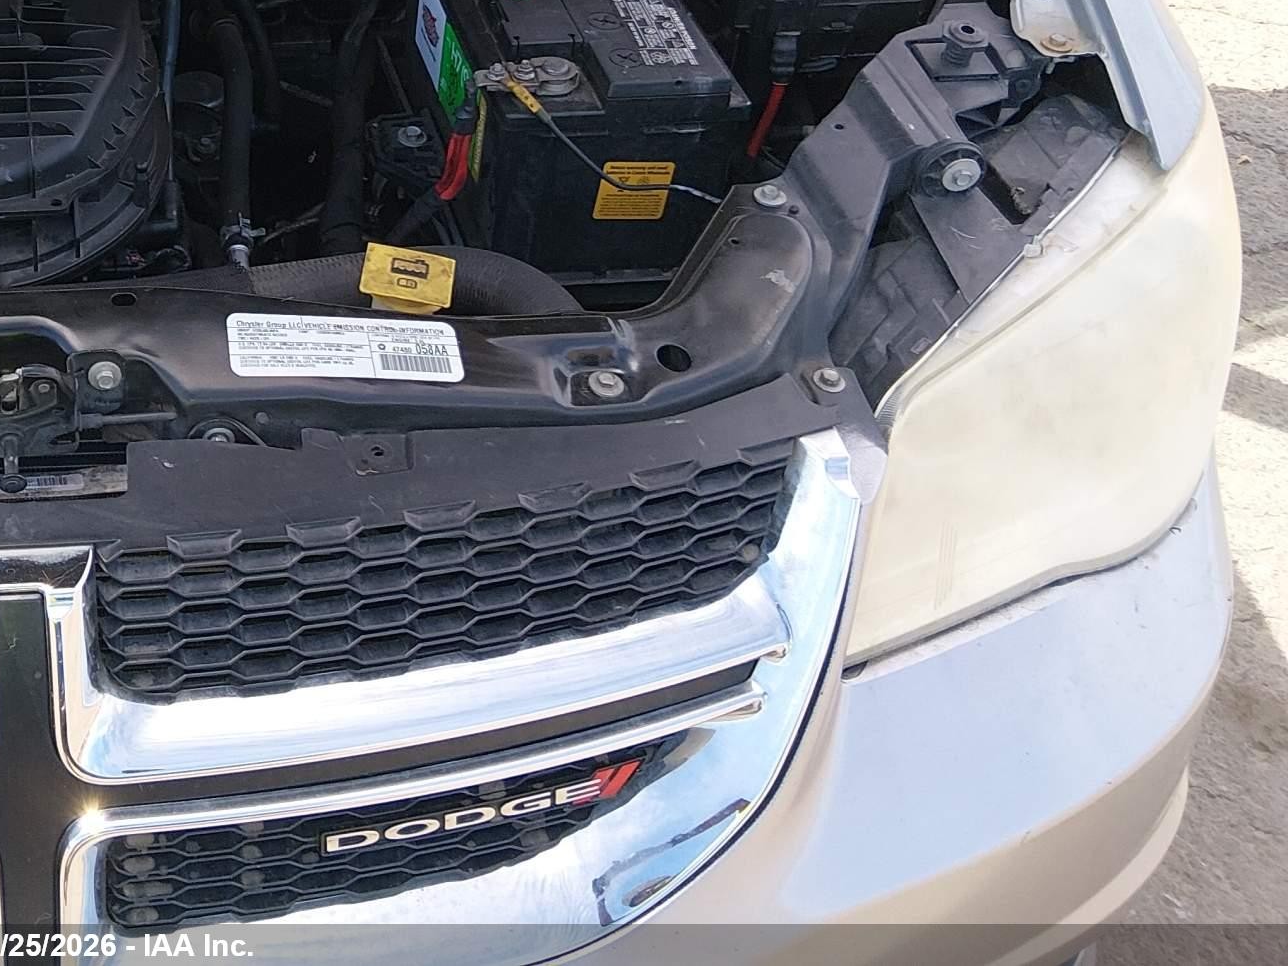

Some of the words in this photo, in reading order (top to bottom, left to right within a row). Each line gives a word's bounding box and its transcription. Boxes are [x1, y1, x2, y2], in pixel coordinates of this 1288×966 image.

[236, 320, 264, 329] Chrysler
[266, 321, 287, 330] Group
[303, 322, 331, 330] VEHICLE
[367, 325, 397, 333] CONTROL
[398, 326, 444, 335] INFORMATION
[415, 343, 448, 355] 058AA
[326, 778, 602, 853] DODGE
